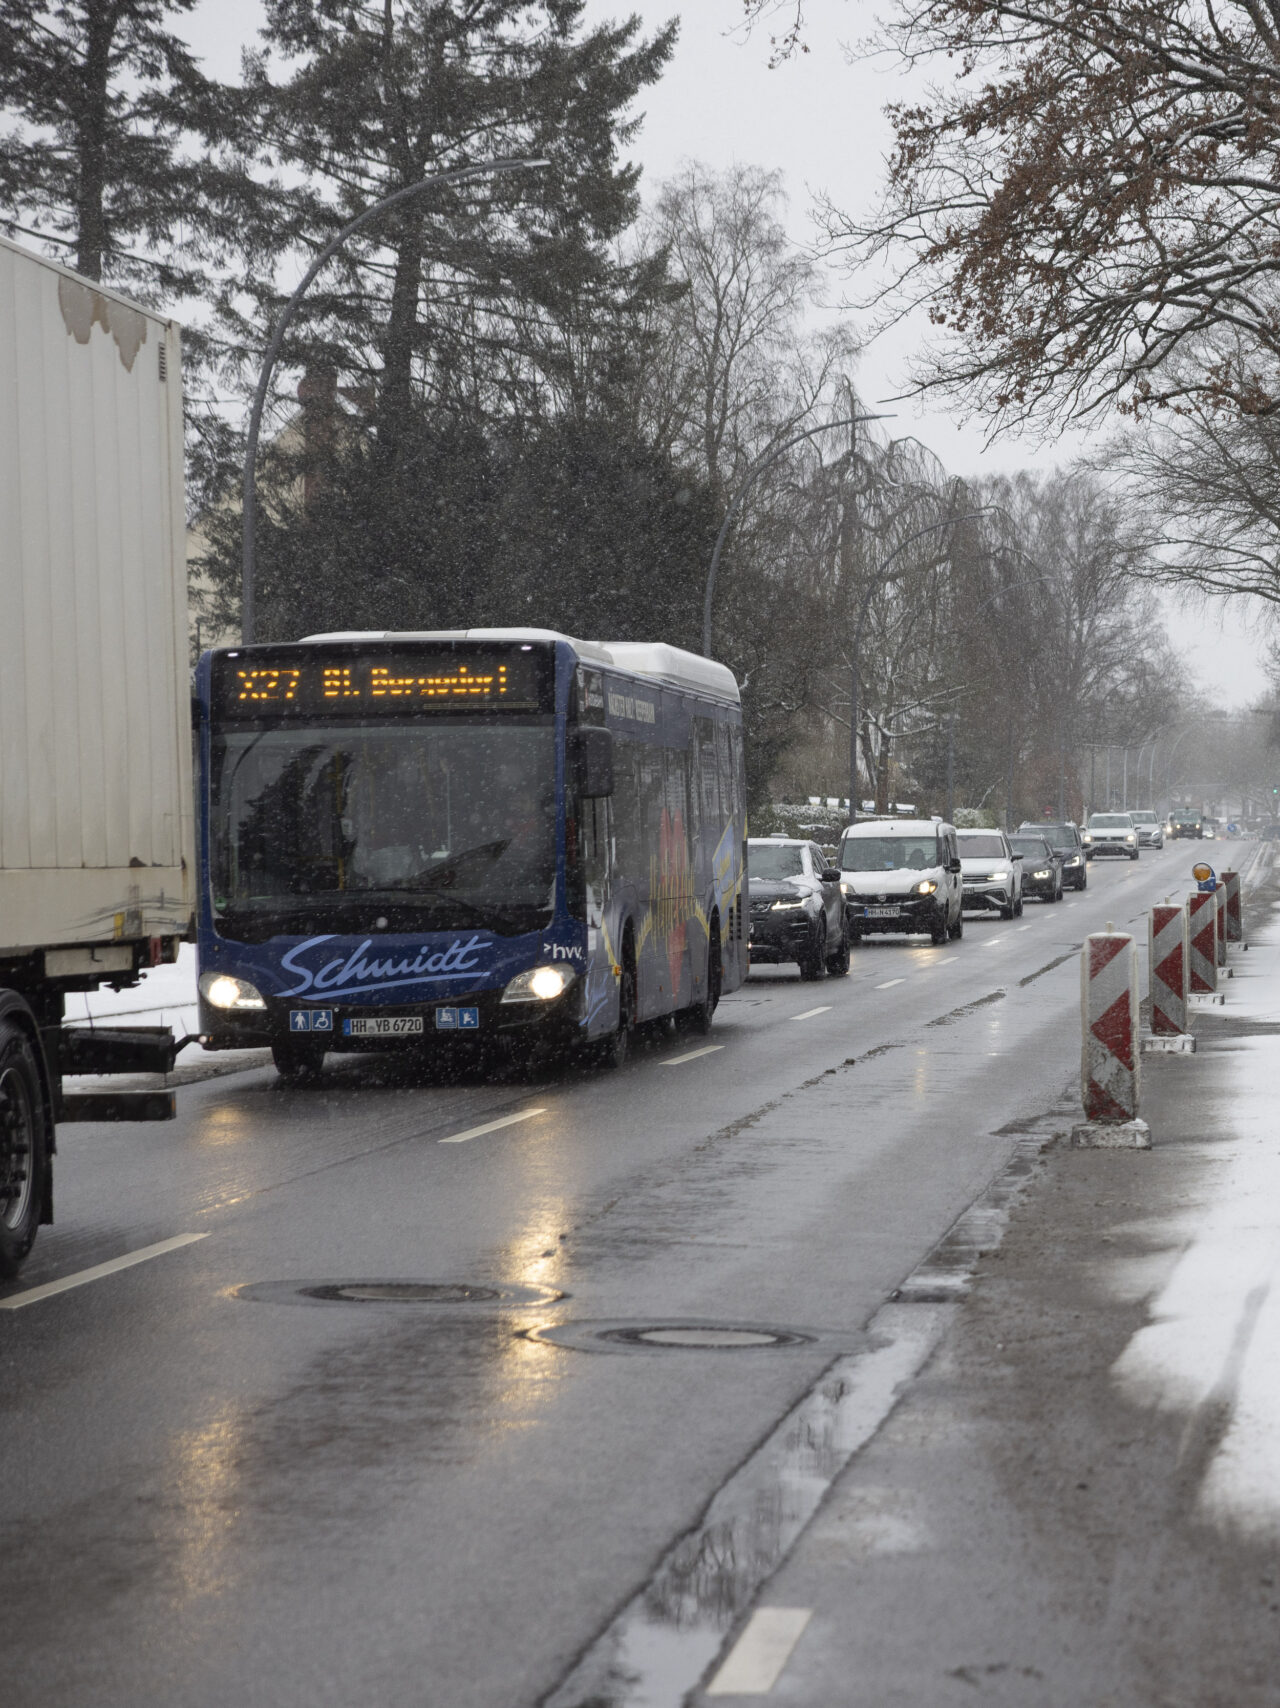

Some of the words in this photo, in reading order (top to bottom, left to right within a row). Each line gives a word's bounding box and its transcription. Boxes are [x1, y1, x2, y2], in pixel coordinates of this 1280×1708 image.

[237, 670, 301, 700] X27
[273, 934, 493, 997] Schmidt
[351, 1020, 367, 1033] HH
[375, 1020, 390, 1032] YB
[393, 1019, 421, 1032] 6720
